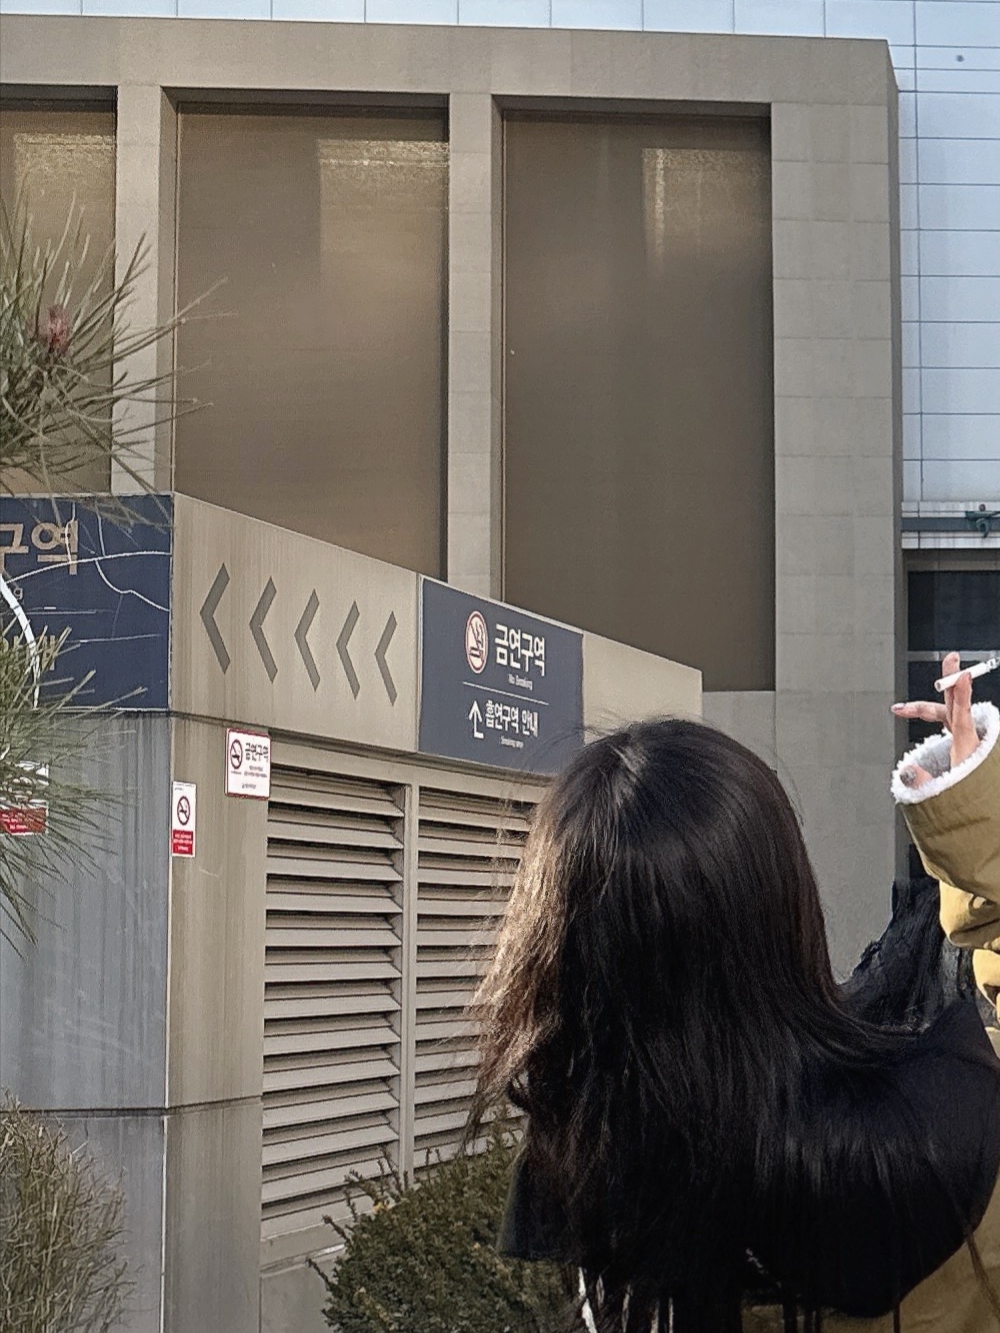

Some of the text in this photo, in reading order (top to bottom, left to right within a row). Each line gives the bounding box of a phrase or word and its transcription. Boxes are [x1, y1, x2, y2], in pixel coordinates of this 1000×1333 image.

[494, 623, 545, 677] 금연구역
[485, 699, 539, 738] 흡연구역 안내
[244, 742, 269, 763] 금연구역
